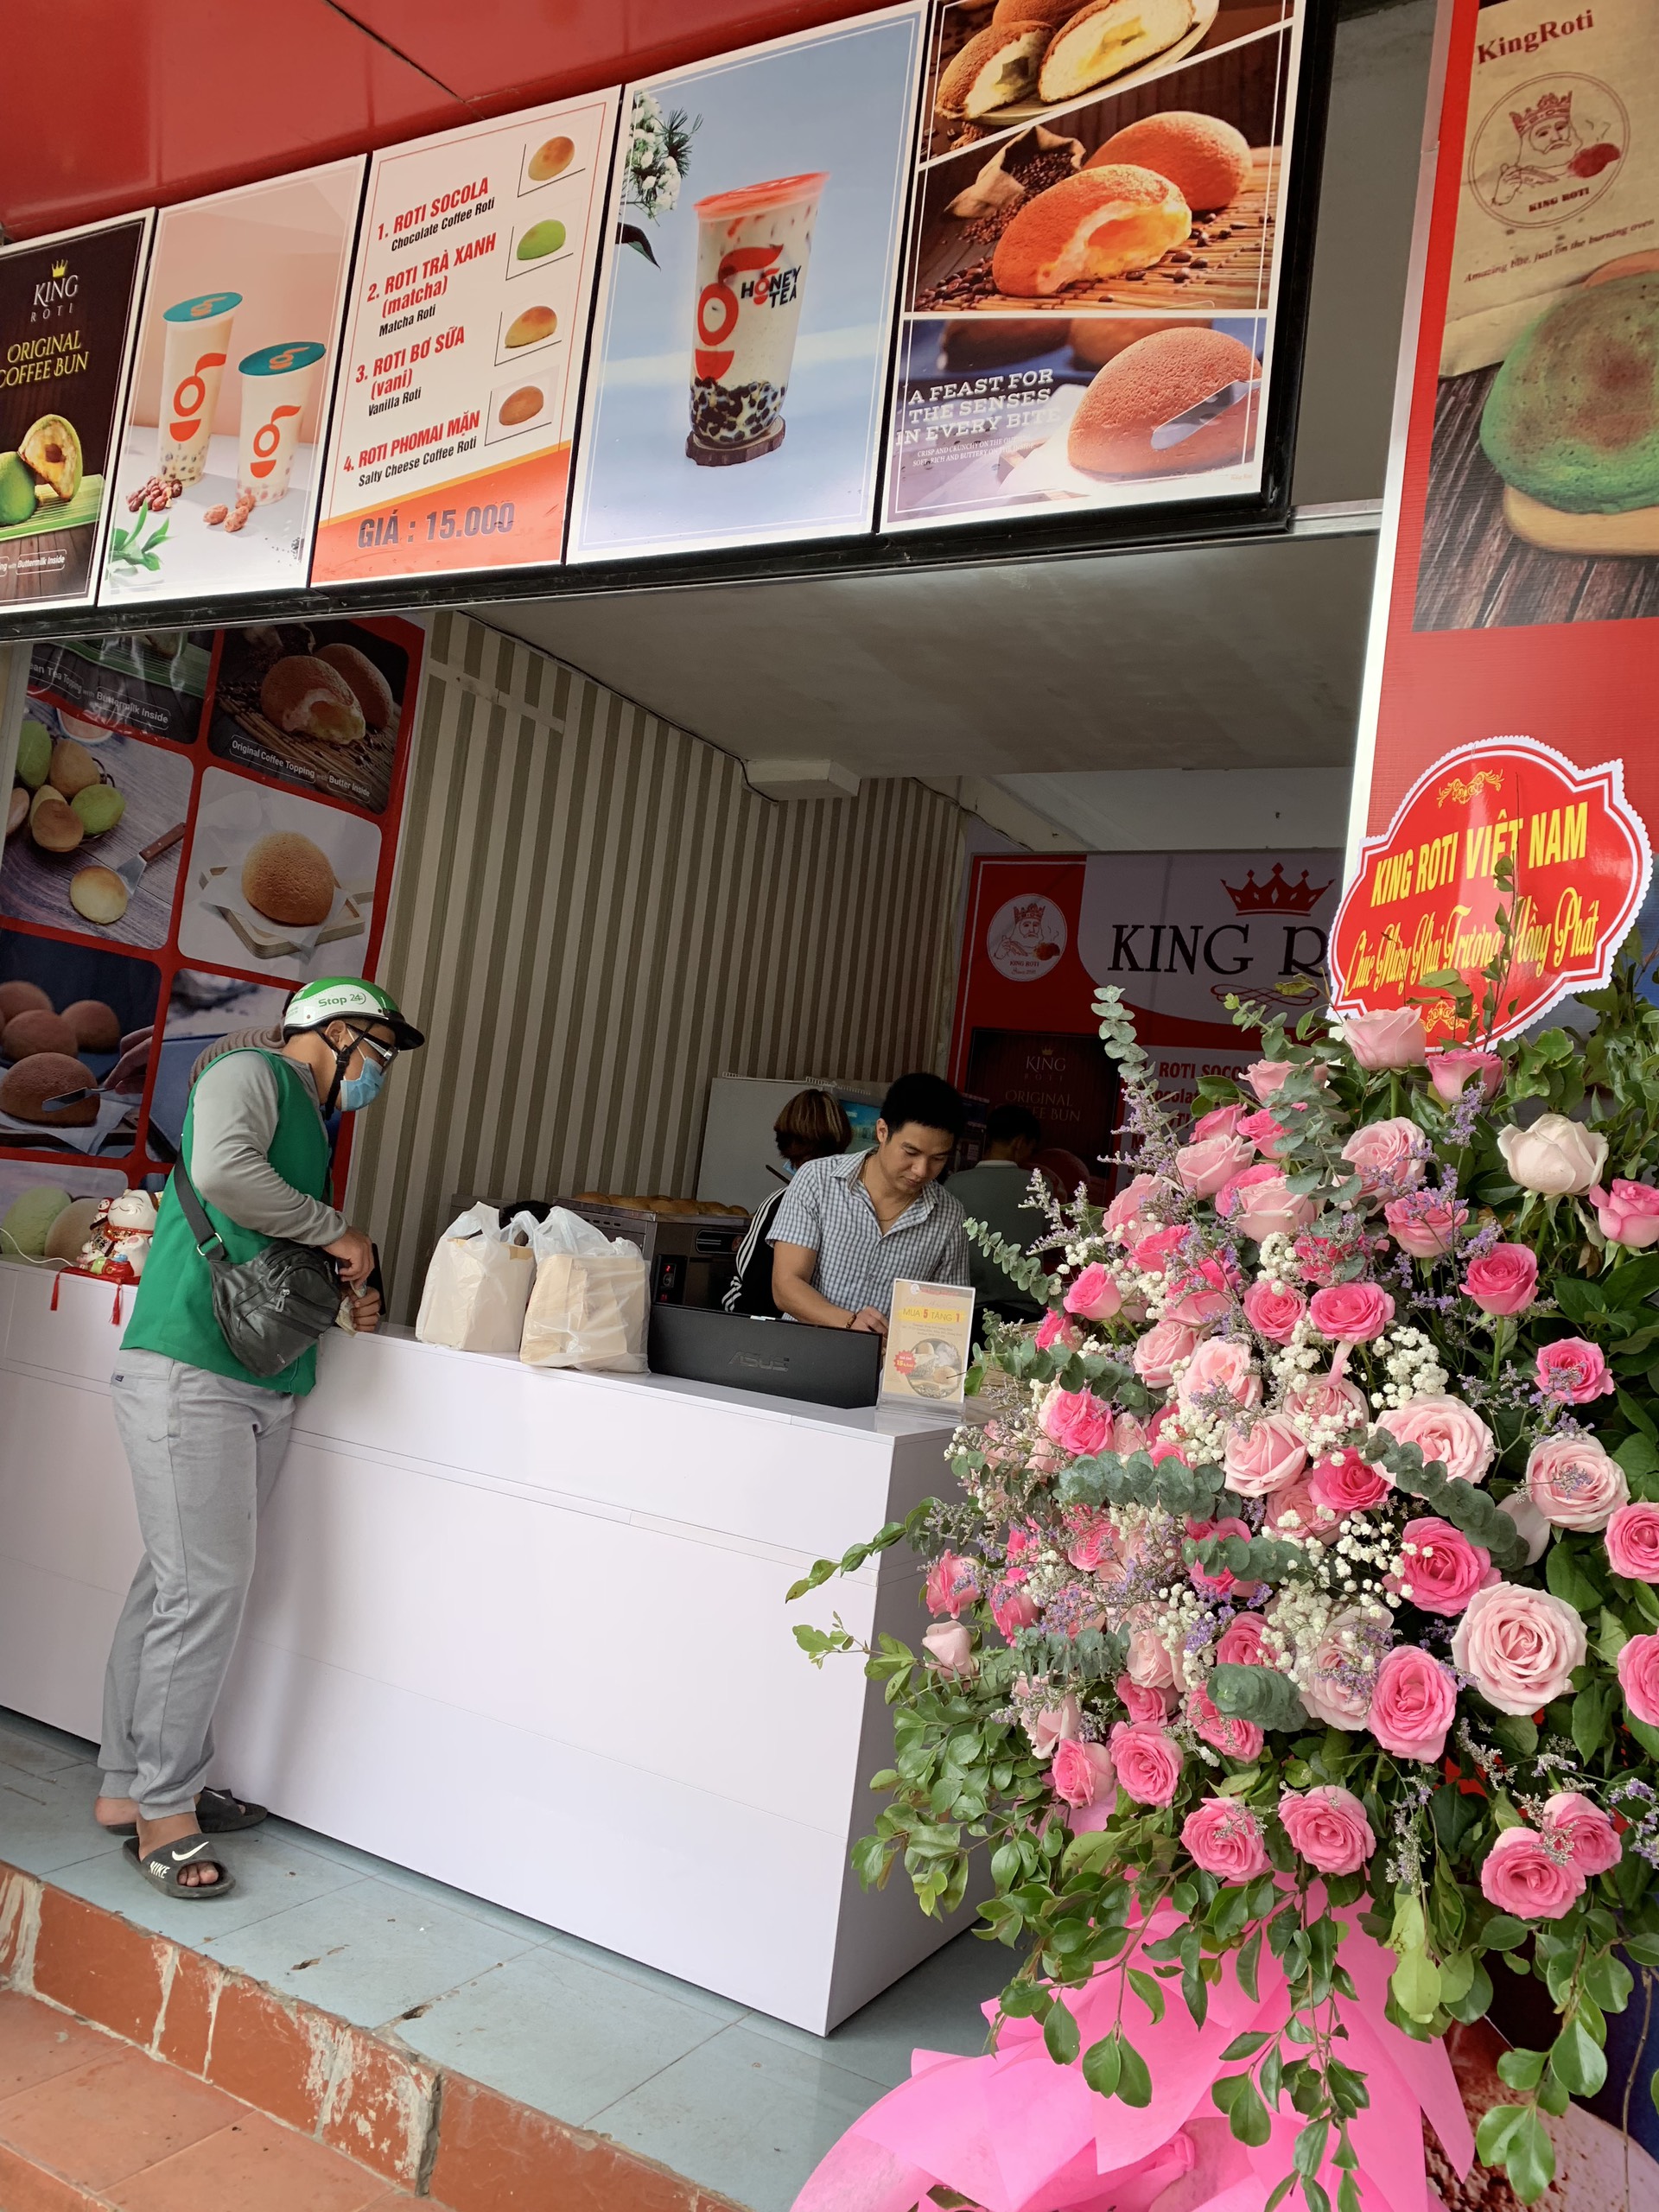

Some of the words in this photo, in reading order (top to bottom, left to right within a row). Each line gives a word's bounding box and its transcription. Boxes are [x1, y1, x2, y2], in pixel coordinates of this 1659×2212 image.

[1477, 9, 1594, 65] KingRoti
[378, 223, 389, 242] 1.
[393, 203, 427, 234] ROTI
[429, 176, 489, 217] SOCOLA
[1529, 197, 1559, 213] KING
[1561, 187, 1591, 202] ROTI
[391, 223, 439, 252] Chocolate
[441, 208, 473, 231] Coffee
[474, 196, 496, 217] Roti
[1570, 239, 1586, 251] the
[1588, 227, 1629, 245] burning
[366, 283, 380, 302] 2.
[385, 265, 419, 296] ROTI
[423, 249, 449, 278] TRÀ
[454, 232, 497, 267] XANH
[34, 275, 79, 307] KING
[381, 275, 448, 319] (matcha)
[741, 265, 802, 302] HONEY
[769, 283, 797, 308] TEA
[30, 302, 73, 322] ROTI
[378, 315, 415, 337] Matcha
[416, 304, 437, 325] Roti
[7, 330, 81, 363] ORIGINAL
[355, 365, 368, 384] 3.
[372, 348, 407, 378] ROTI
[410, 336, 432, 364] BƠ
[435, 324, 466, 354] SỮA
[54, 351, 89, 377] BUN
[371, 368, 413, 400] (vani)
[908, 389, 925, 405] A
[929, 376, 1004, 402] FEAST
[1007, 368, 1054, 390] FOR
[368, 397, 400, 416] Vanilla
[402, 386, 423, 404] Roti
[909, 404, 954, 424] THE
[959, 388, 1052, 416] SENSES
[343, 454, 355, 473] 4.
[358, 442, 388, 468] ROTI
[390, 423, 444, 457] PHOMAI
[447, 410, 480, 437] MẶN
[895, 428, 921, 446] IN
[925, 416, 1003, 442] EVERY
[1006, 408, 1062, 429] BITE
[359, 470, 383, 487] Salty
[385, 458, 421, 479] Cheese
[423, 445, 454, 465] Coffee
[457, 435, 477, 454] Roti
[917, 448, 936, 458] CRISP
[935, 446, 949, 456] AND
[949, 442, 979, 454] CRUNCHY
[979, 441, 989, 449] ON
[989, 439, 1002, 448] THE
[930, 454, 945, 464] RICH
[946, 452, 960, 462] AND
[960, 448, 988, 460] BUTTERY
[357, 508, 399, 549] GIÁ
[408, 519, 416, 543] :
[426, 502, 516, 542] 15.000
[17, 556, 48, 569] Buttermilk
[47, 554, 66, 566] Inside
[48, 666, 62, 680] Tea
[63, 673, 82, 694] Topping
[96, 691, 140, 715] Buttermilk
[142, 707, 168, 723] Inside
[232, 740, 260, 759] Original
[261, 750, 284, 767] Coffee
[285, 760, 315, 779] Topping
[329, 774, 351, 790] Butter
[352, 782, 371, 798] Inside
[1370, 847, 1414, 907] KING
[1415, 831, 1459, 894] ROTI
[1528, 801, 1589, 870] NAM
[1107, 924, 1254, 975] KING
[318, 997, 347, 1007] Stop
[1026, 1056, 1066, 1072] KING
[1159, 1062, 1196, 1079] ROTI
[1201, 1065, 1251, 1082] SOCO
[1005, 1090, 1073, 1107] ORIGINAL
[1051, 1109, 1081, 1122] BUN
[903, 1308, 921, 1318] MUA
[923, 1308, 929, 1319] 5
[955, 1313, 961, 1323] 1
[728, 1350, 789, 1372] ASUS
[149, 1861, 170, 1878] NIKE
